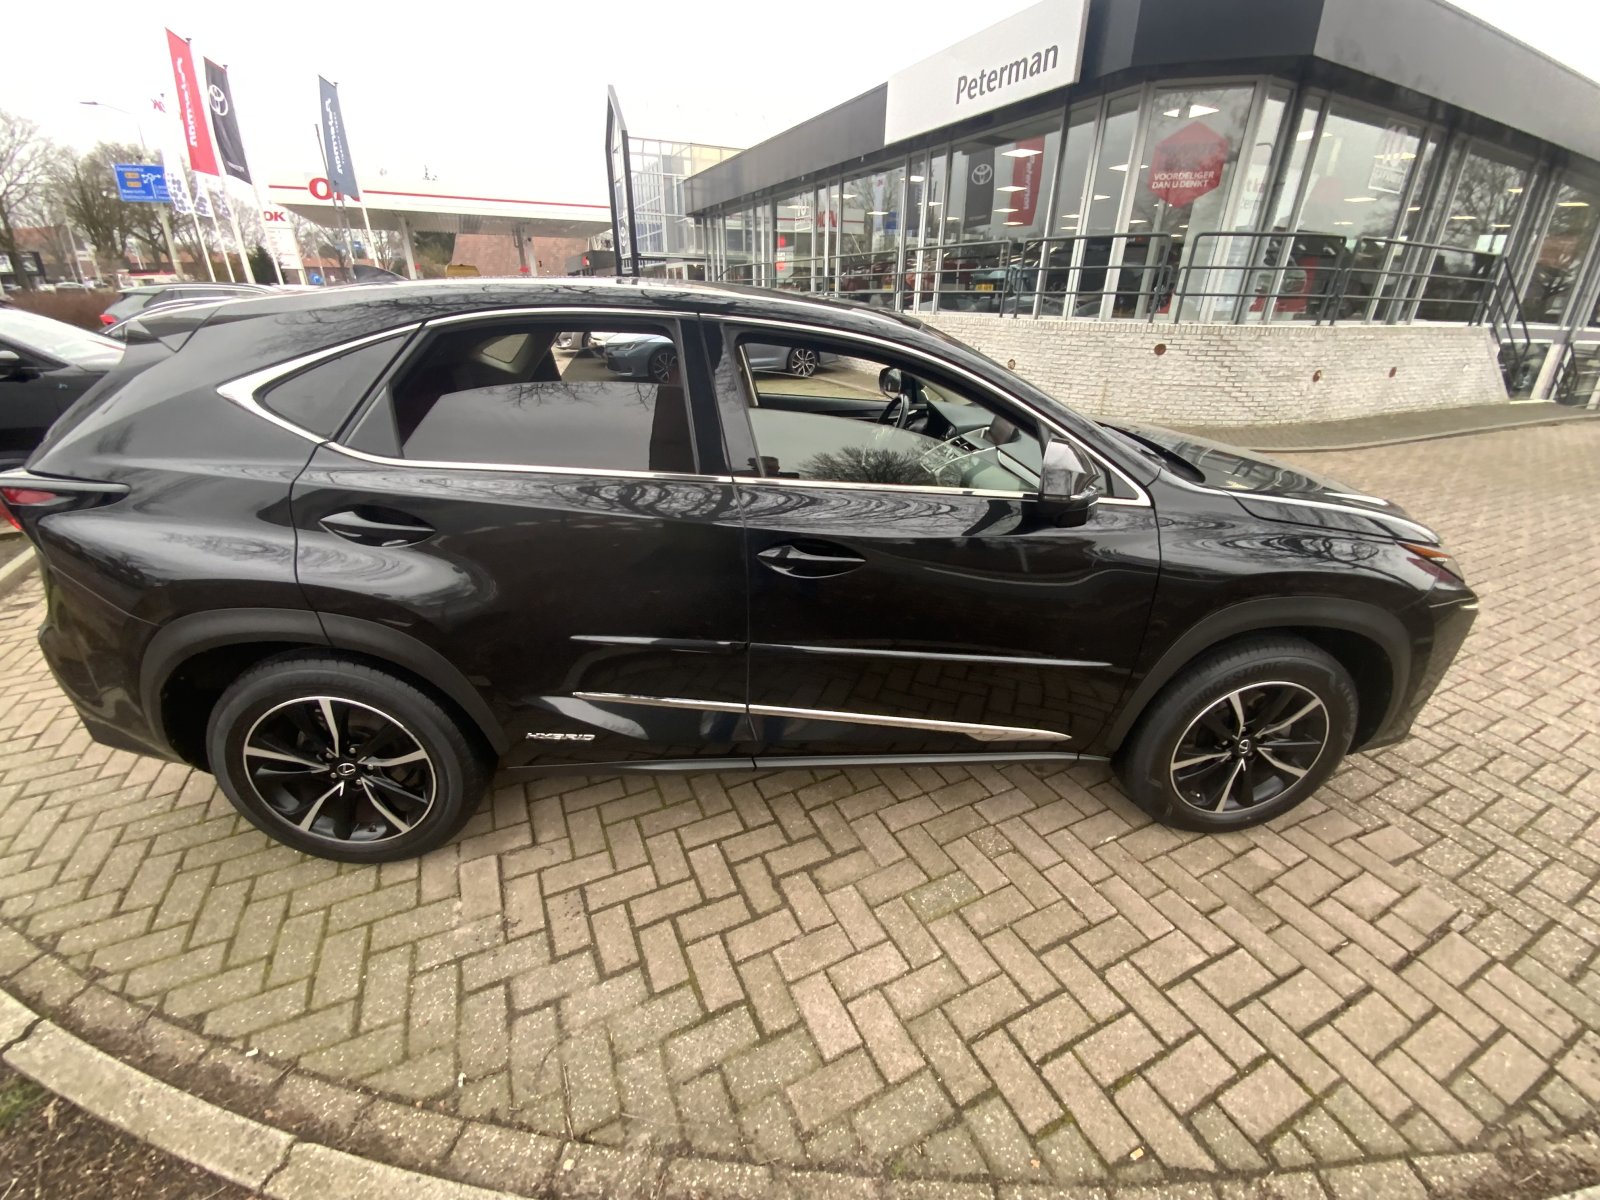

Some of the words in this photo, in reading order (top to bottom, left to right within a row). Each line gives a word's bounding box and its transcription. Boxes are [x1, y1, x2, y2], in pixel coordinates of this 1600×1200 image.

[955, 44, 1059, 105] Peterman
[1153, 170, 1215, 181] VOORDELIGER
[1151, 181, 1171, 189] DAN
[1172, 180, 1179, 188] U
[1179, 179, 1210, 188] DENKT
[525, 732, 596, 741] HYBRID
